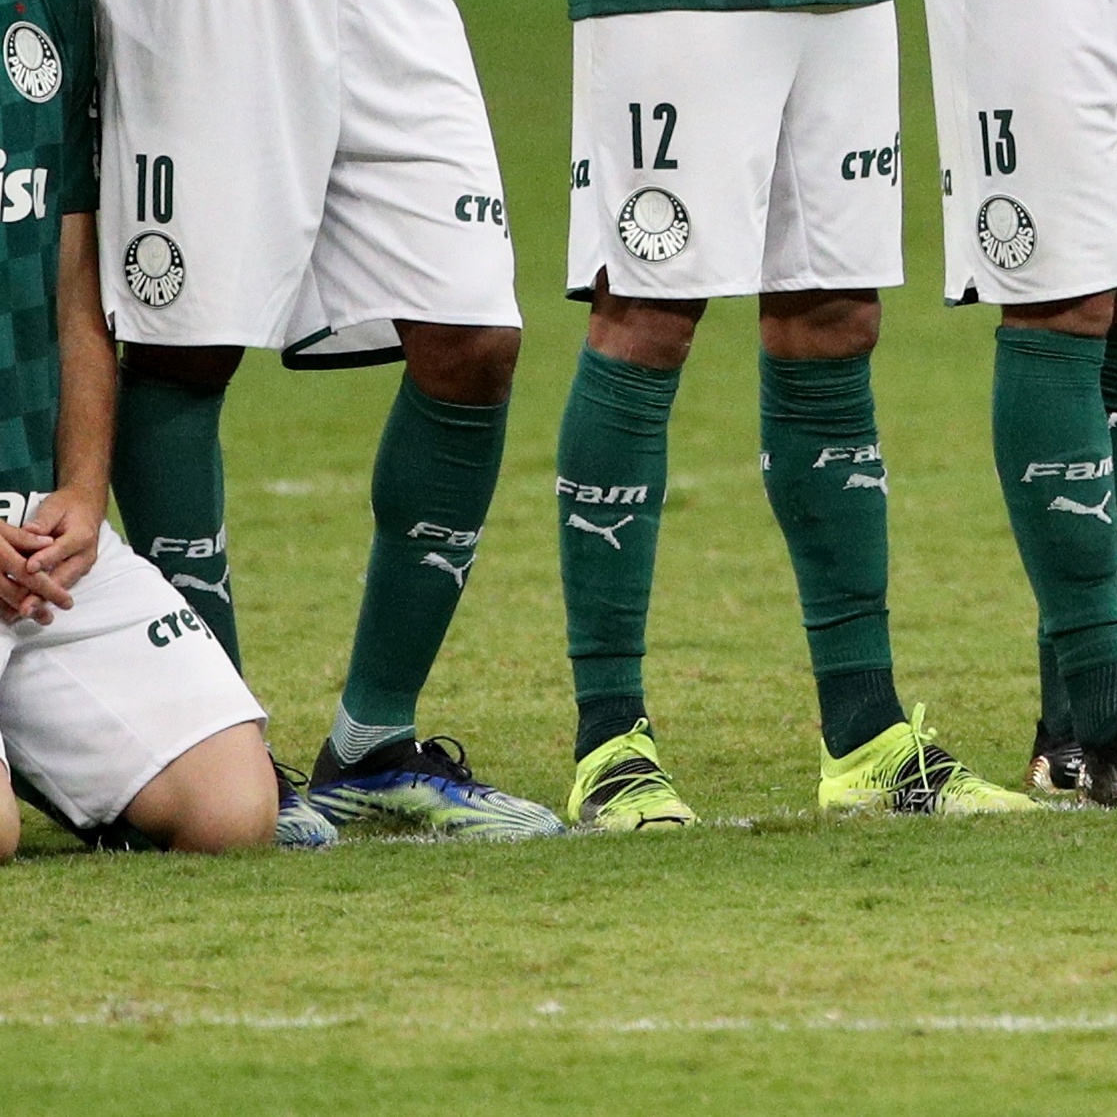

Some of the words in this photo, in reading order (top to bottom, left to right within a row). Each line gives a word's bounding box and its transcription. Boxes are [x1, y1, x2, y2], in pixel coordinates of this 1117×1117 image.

[8, 56, 58, 96] PALMEIRAS
[628, 102, 679, 171] 12
[978, 109, 1018, 176] 13
[136, 154, 174, 224] 10
[455, 194, 508, 239] cre
[619, 220, 688, 261] PALMEIRAS
[979, 227, 1034, 269] PALMEIRAS
[125, 263, 184, 306] PALMEIRAS
